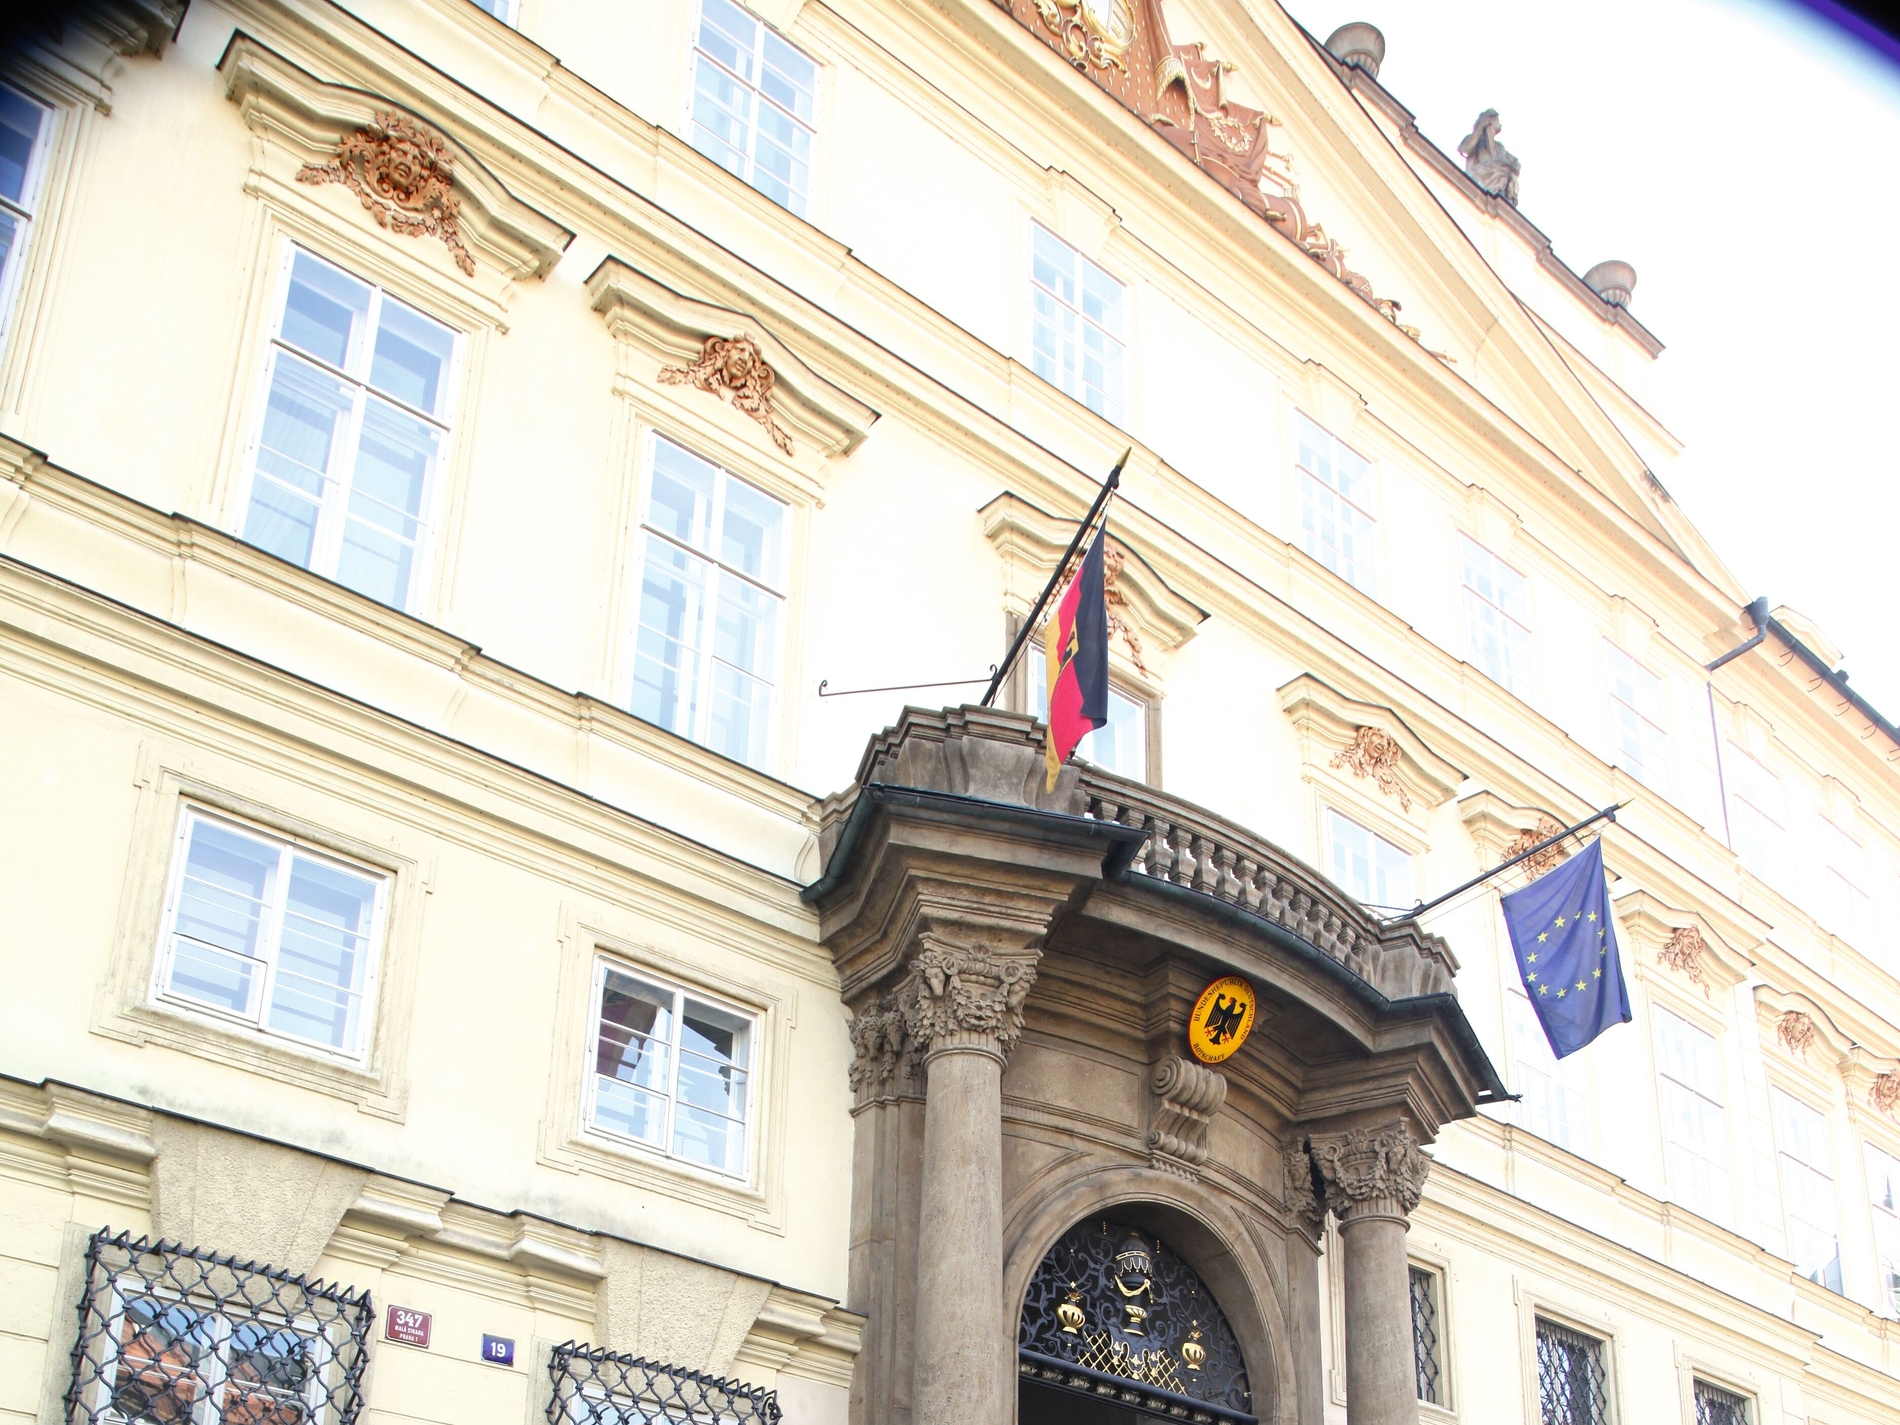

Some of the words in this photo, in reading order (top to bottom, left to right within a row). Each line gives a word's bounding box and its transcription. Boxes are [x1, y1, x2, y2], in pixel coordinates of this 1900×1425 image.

[1194, 978, 1243, 1022] BUNDESREPUBLIK
[1240, 985, 1254, 1040] DEUTSCHLAND
[1193, 1042, 1225, 1061] BOTSCHAFT
[396, 1310, 423, 1328] 347
[400, 1333, 414, 1341] PRAHA
[491, 1342, 506, 1358] 19
